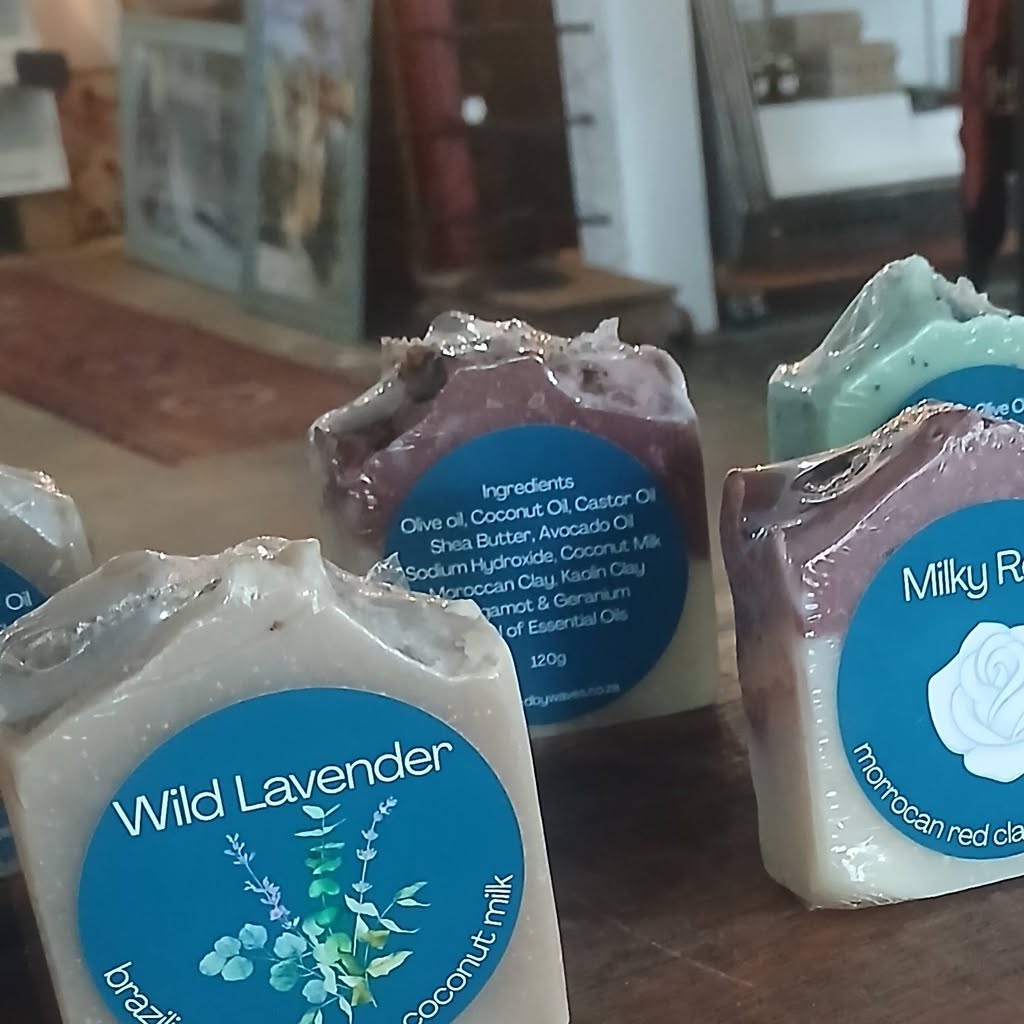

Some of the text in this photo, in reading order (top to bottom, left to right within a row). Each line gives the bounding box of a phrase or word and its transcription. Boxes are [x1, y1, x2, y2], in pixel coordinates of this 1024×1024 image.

[482, 475, 575, 501] Ingredients
[401, 487, 657, 535] Olive oil, Coconut Oil, Castor Oil
[430, 513, 635, 555] Shea Butter, Avocado Oil
[406, 533, 662, 582] Sodium Hydroxide, Coconut Milk
[5, 591, 32, 610] Oil
[429, 578, 515, 600] Moroccan
[560, 565, 607, 583] Kaolin
[609, 560, 646, 578] Clay
[902, 557, 989, 602] Milky
[481, 586, 632, 620] gamot & Geranium
[506, 622, 524, 638] of
[528, 612, 597, 635] Essential
[599, 608, 629, 625] Oils
[530, 653, 568, 671] 120g
[112, 740, 454, 838] Wild Lavender
[852, 742, 945, 840] morrocan
[947, 823, 990, 848] red
[482, 873, 515, 930] milk
